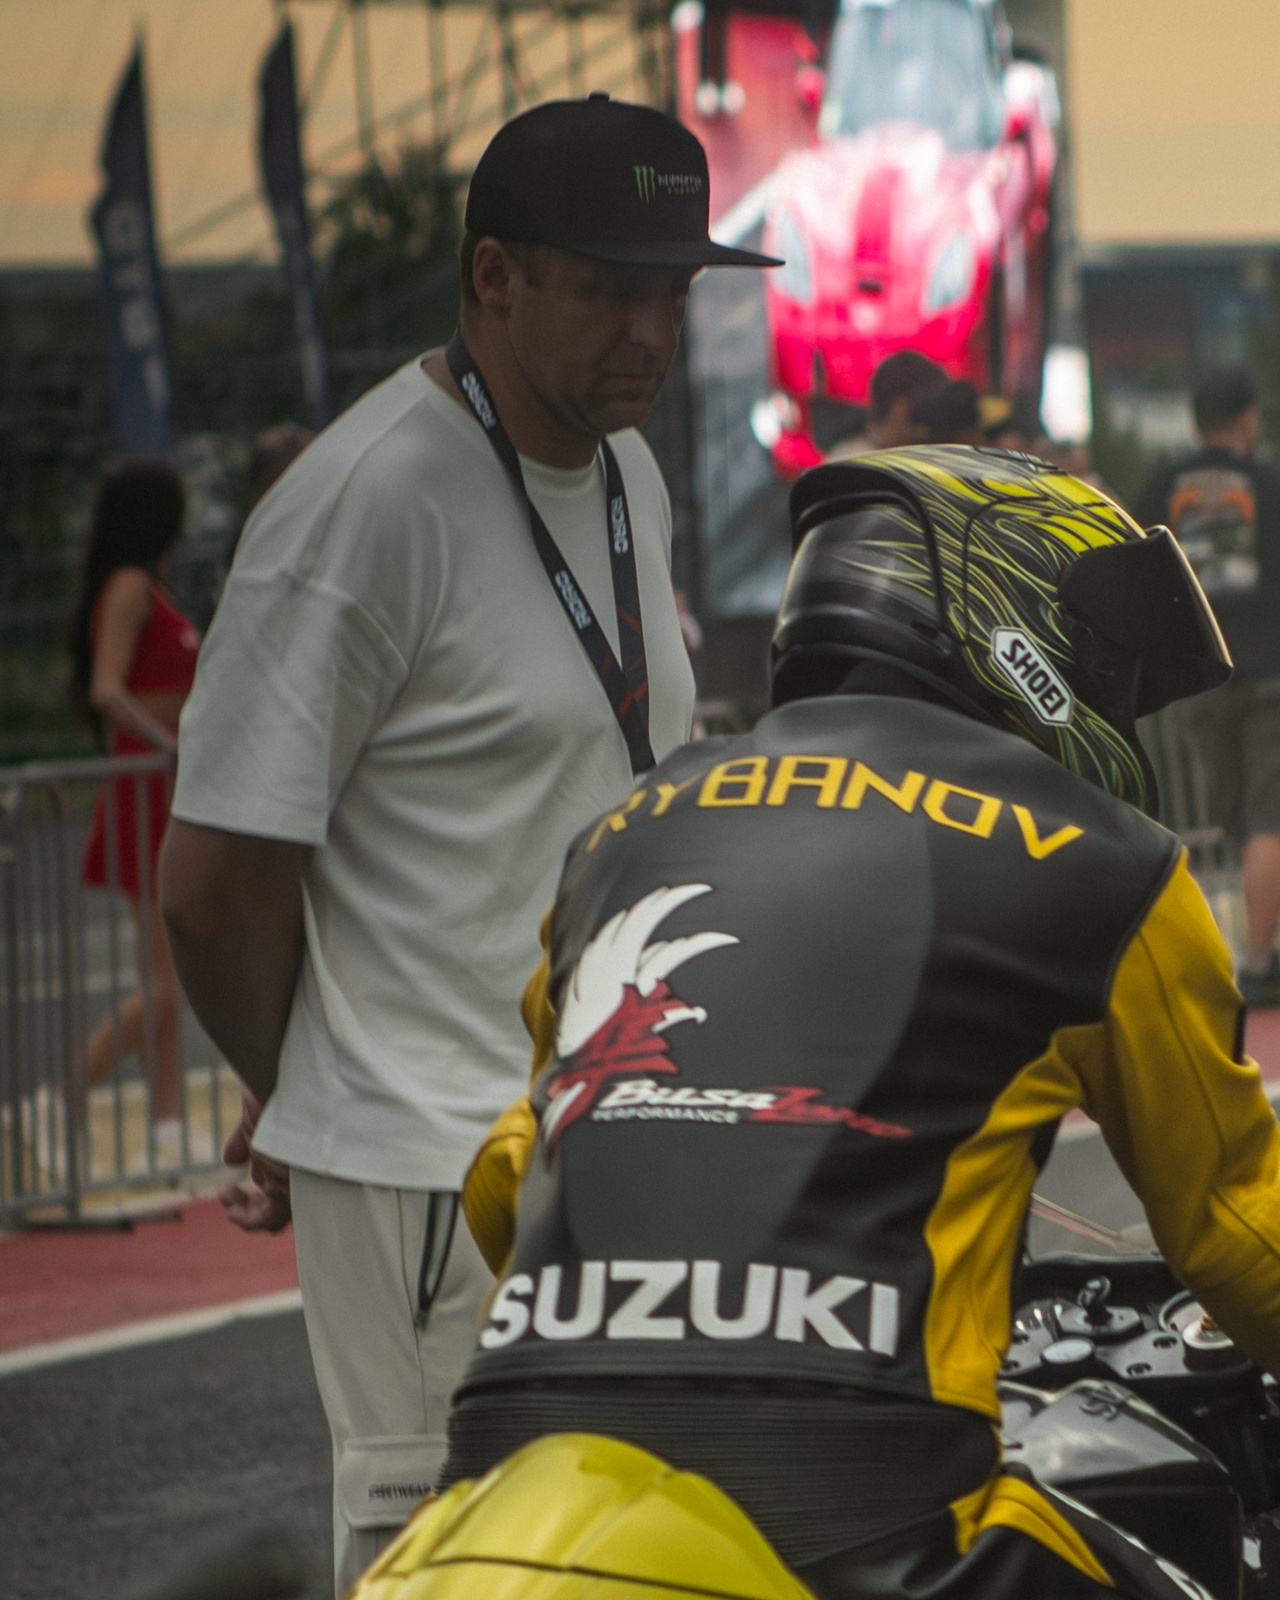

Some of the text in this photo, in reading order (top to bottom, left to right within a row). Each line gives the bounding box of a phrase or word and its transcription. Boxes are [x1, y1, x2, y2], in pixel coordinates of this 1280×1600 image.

[1001, 638, 1067, 717] SHOEI
[585, 755, 1084, 860] RYBANOV
[480, 1259, 899, 1358] SUZUKI
